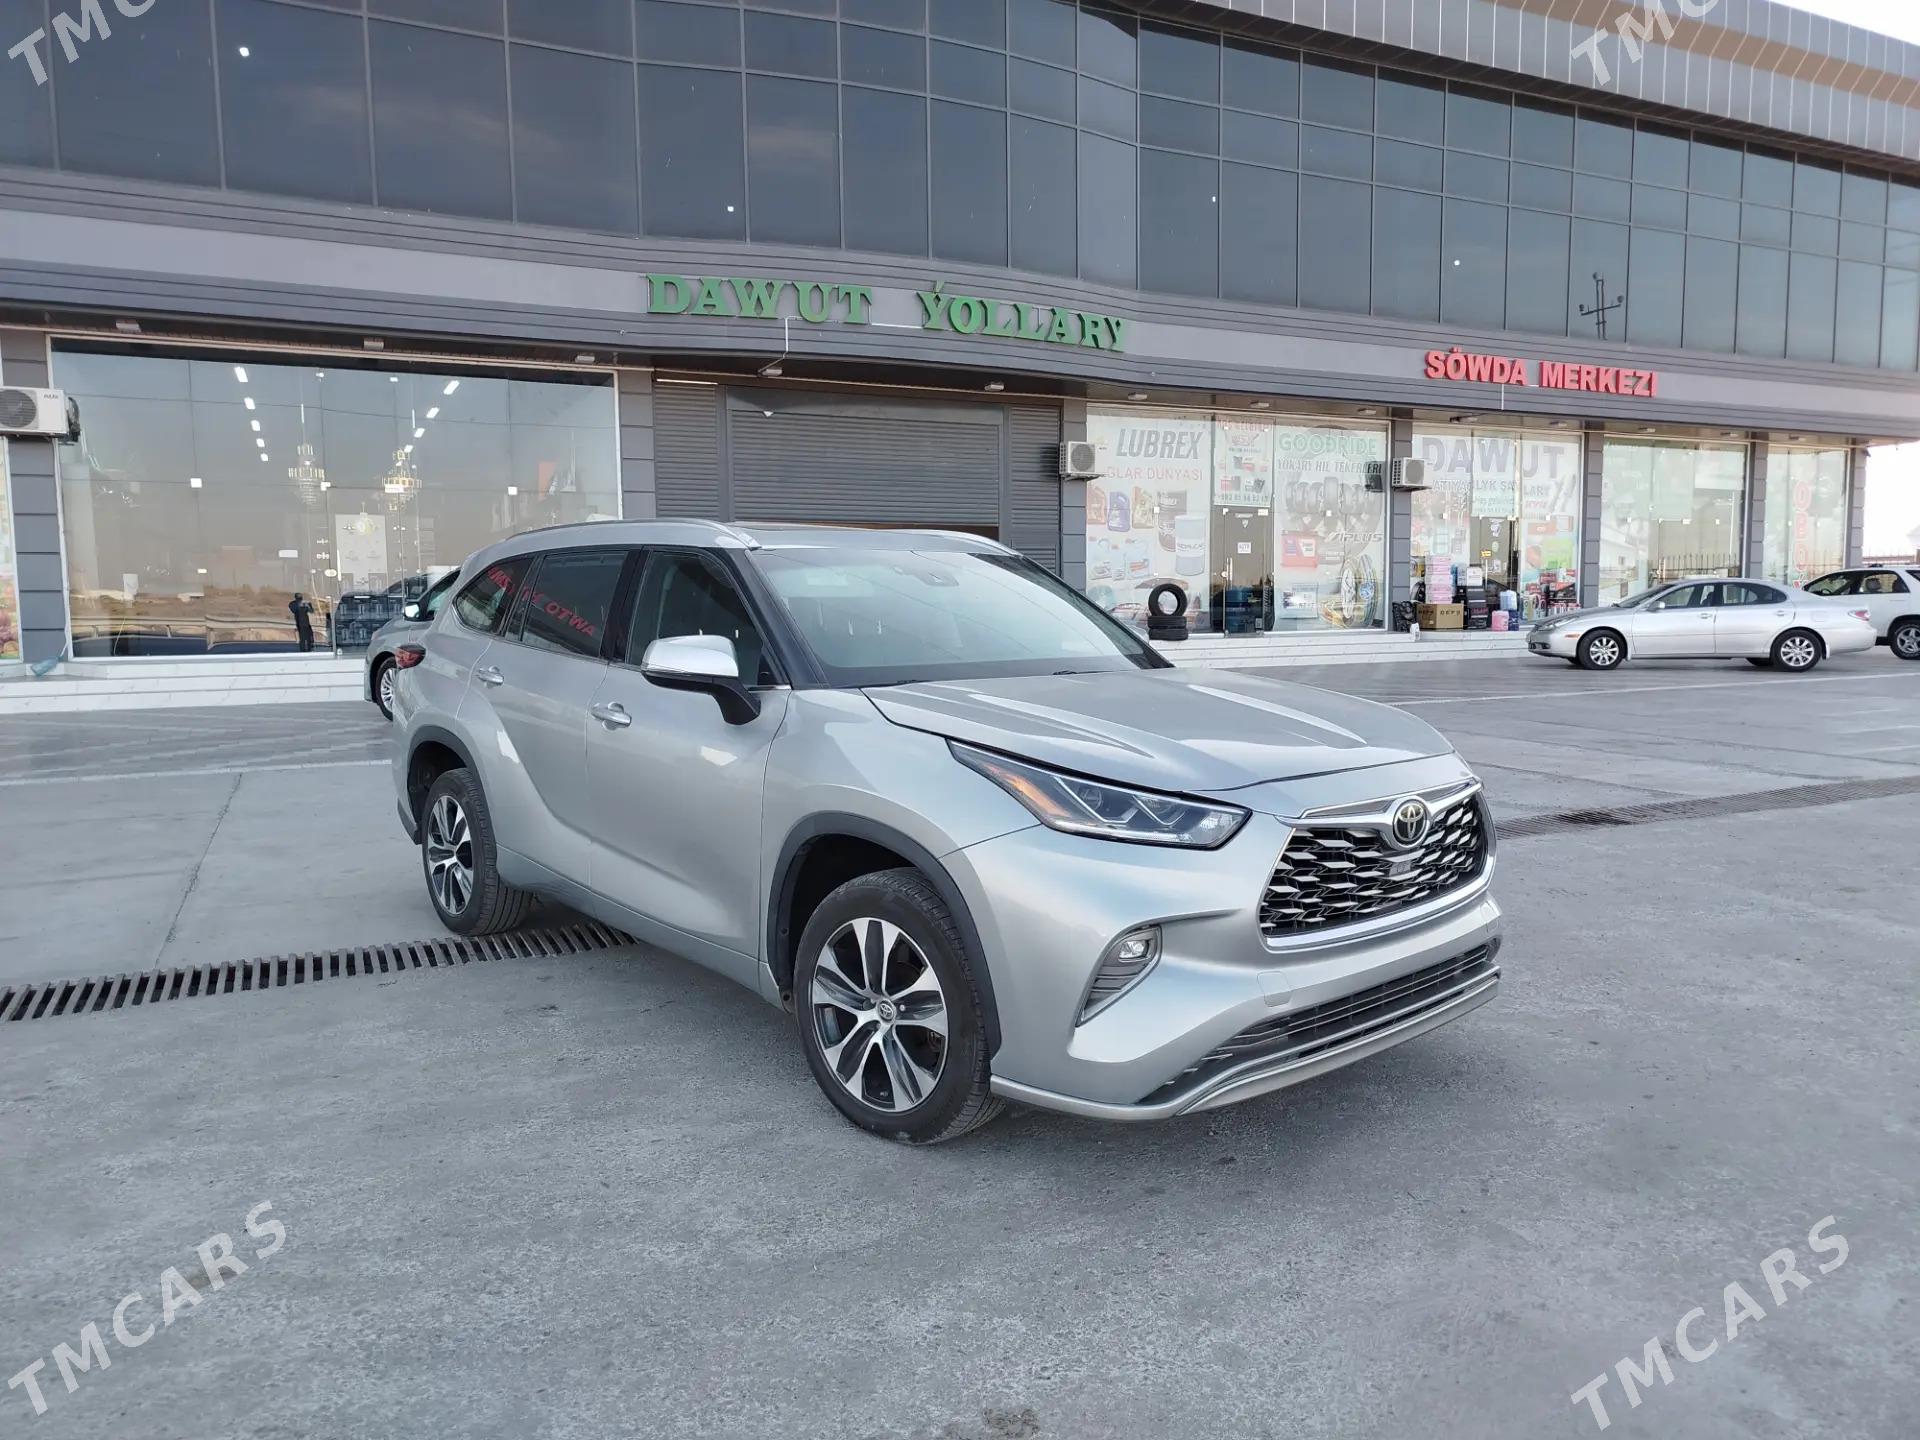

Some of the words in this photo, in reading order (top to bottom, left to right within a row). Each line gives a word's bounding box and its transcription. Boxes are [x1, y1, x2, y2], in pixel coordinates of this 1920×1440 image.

[646, 273, 872, 324] DAWUT
[917, 280, 1126, 353] ÝOLLARY
[1424, 344, 1528, 386] SÖWDA
[1539, 360, 1658, 398] MERKEZI
[1116, 428, 1203, 459] LUBREX
[1279, 432, 1378, 456] GOODRIDE
[1422, 436, 1565, 478] DAWUT
